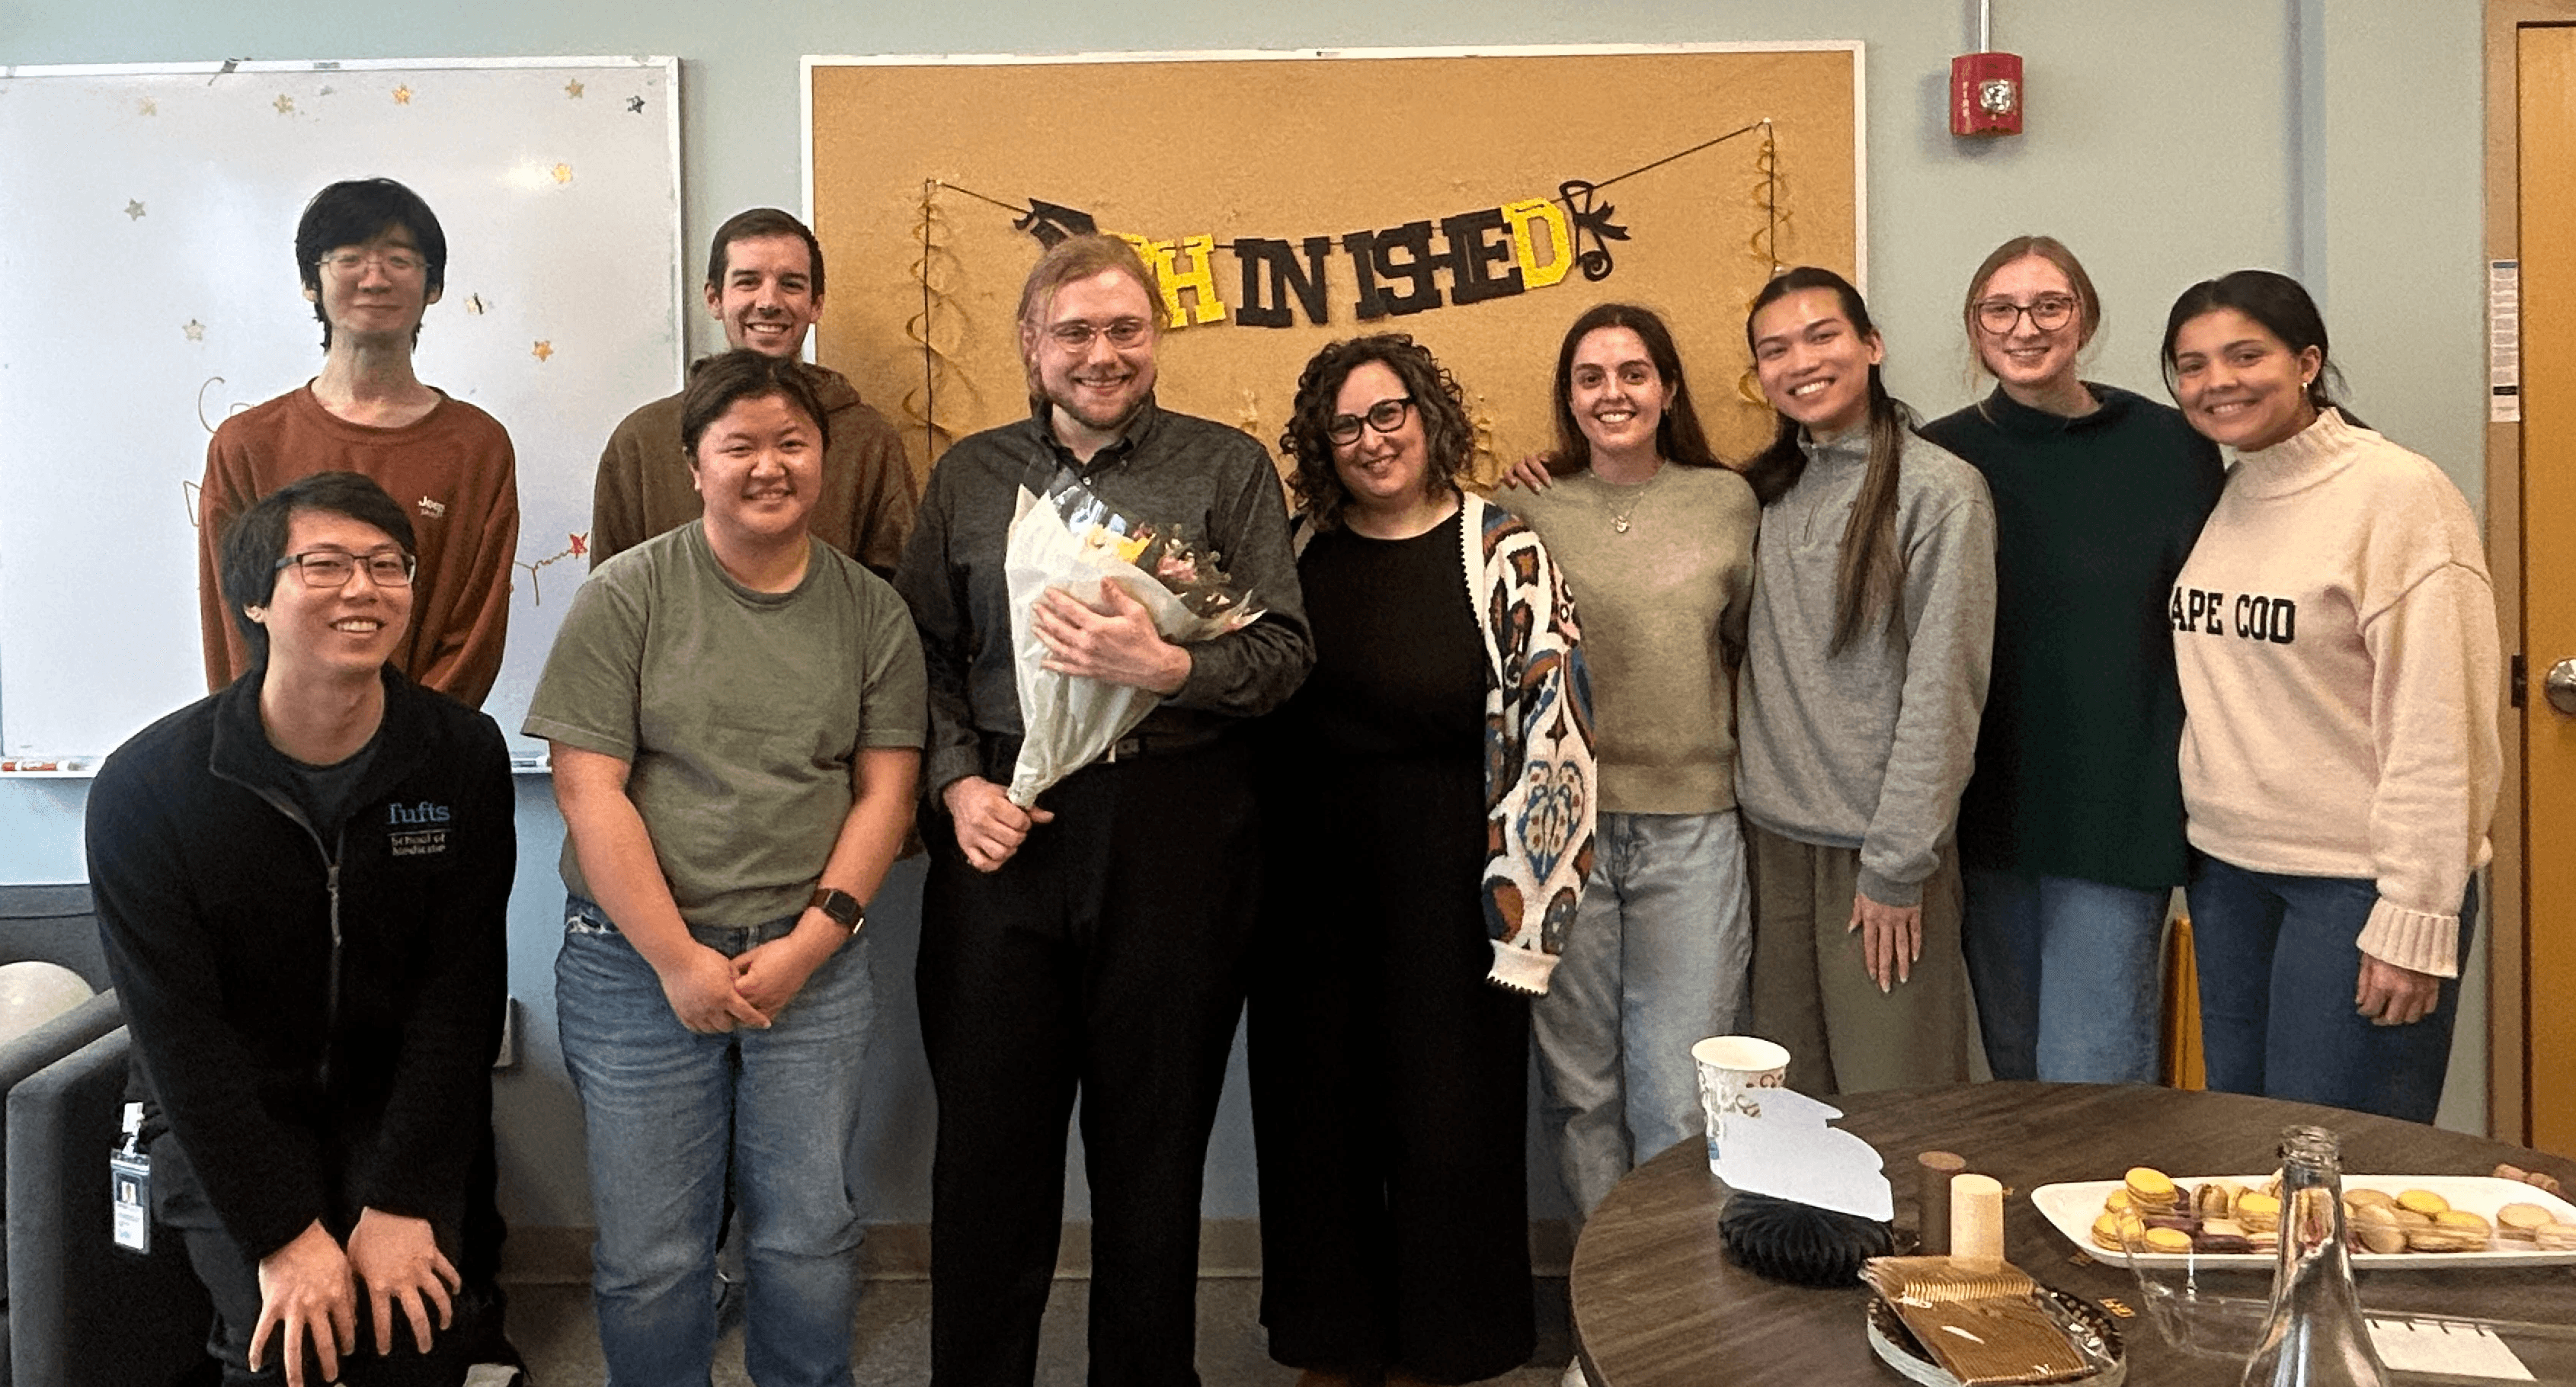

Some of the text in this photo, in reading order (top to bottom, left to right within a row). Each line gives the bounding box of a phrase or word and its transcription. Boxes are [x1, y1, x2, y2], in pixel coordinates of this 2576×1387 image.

[2172, 586, 2296, 644] APE COD
[389, 801, 450, 824] Tufts
